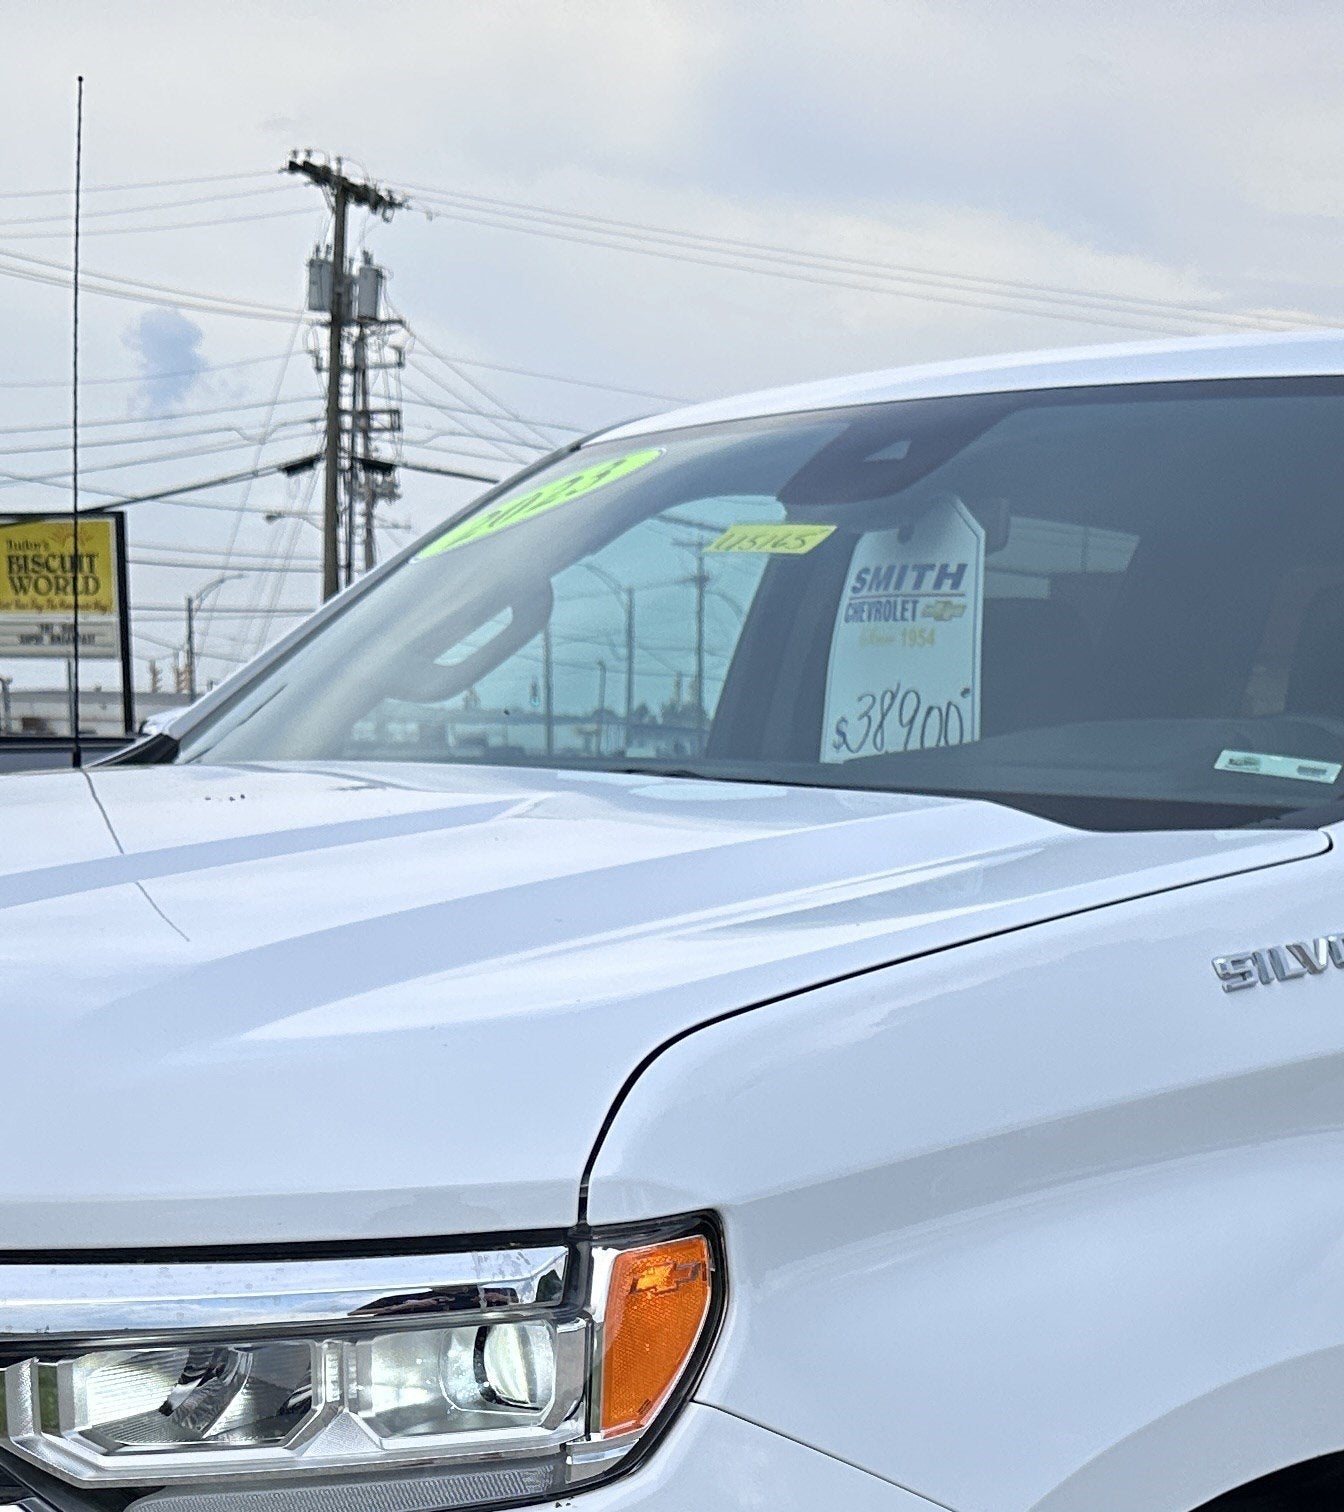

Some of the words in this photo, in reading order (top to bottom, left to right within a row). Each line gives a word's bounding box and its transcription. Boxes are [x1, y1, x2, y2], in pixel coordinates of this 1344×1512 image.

[7, 552, 100, 575] BISCUIT
[8, 574, 102, 597] WORLD
[851, 562, 969, 593] SMITH
[844, 599, 919, 624] CHEVROLET
